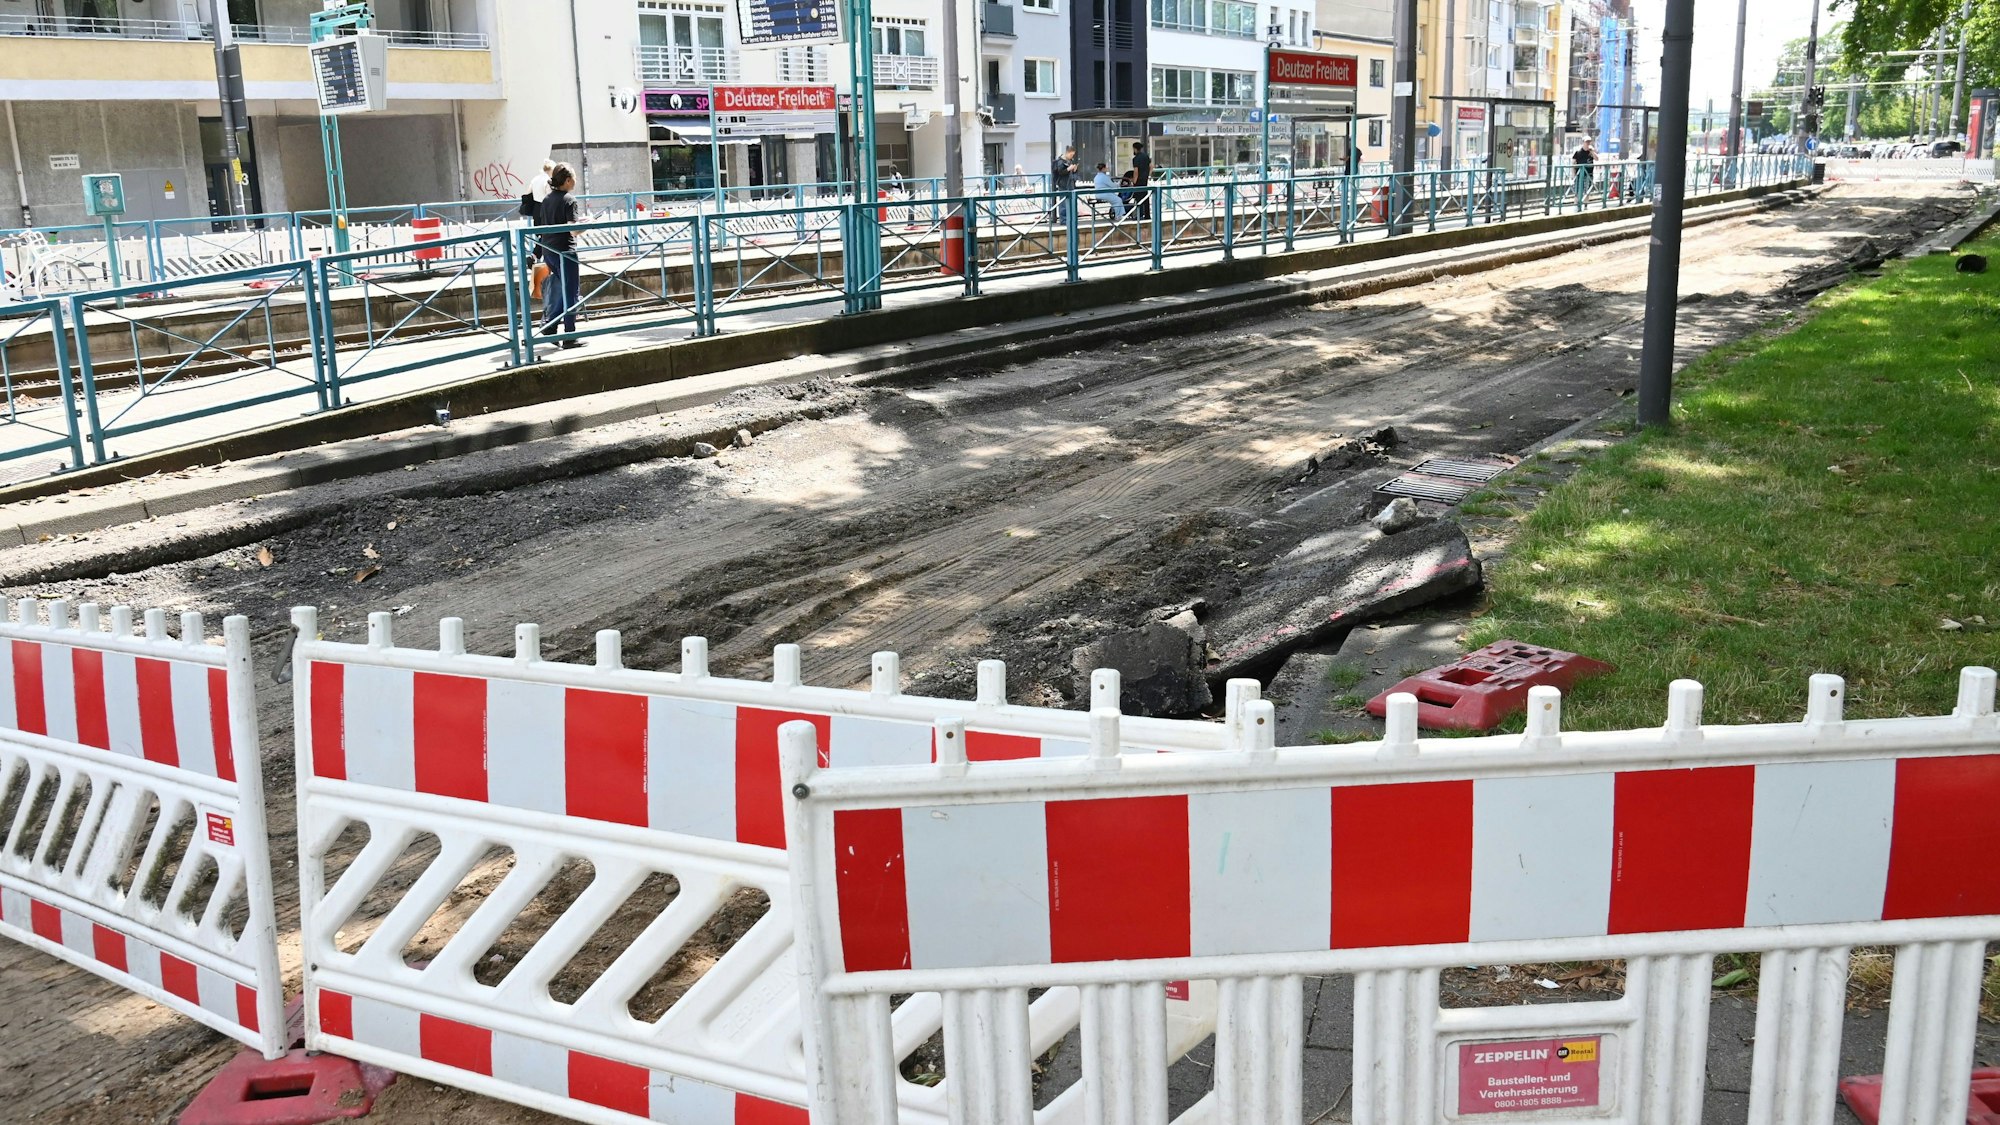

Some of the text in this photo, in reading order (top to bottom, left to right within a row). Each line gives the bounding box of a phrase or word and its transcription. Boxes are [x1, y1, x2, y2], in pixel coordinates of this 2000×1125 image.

[1277, 57, 1350, 81] Deutzer Freiheit
[724, 90, 776, 107] Deutzer
[778, 89, 825, 106] Freiheit
[1175, 125, 1197, 133] Garage
[1217, 125, 1235, 133] Hotel
[1475, 1049, 1548, 1063] ZEPPELIN
[1488, 1072, 1571, 1086] Baustellen- und
[1479, 1085, 1578, 1099] Verkehrssicherung
[1494, 1098, 1539, 1109] 0800-1805
[1541, 1096, 1562, 1106] 8888
